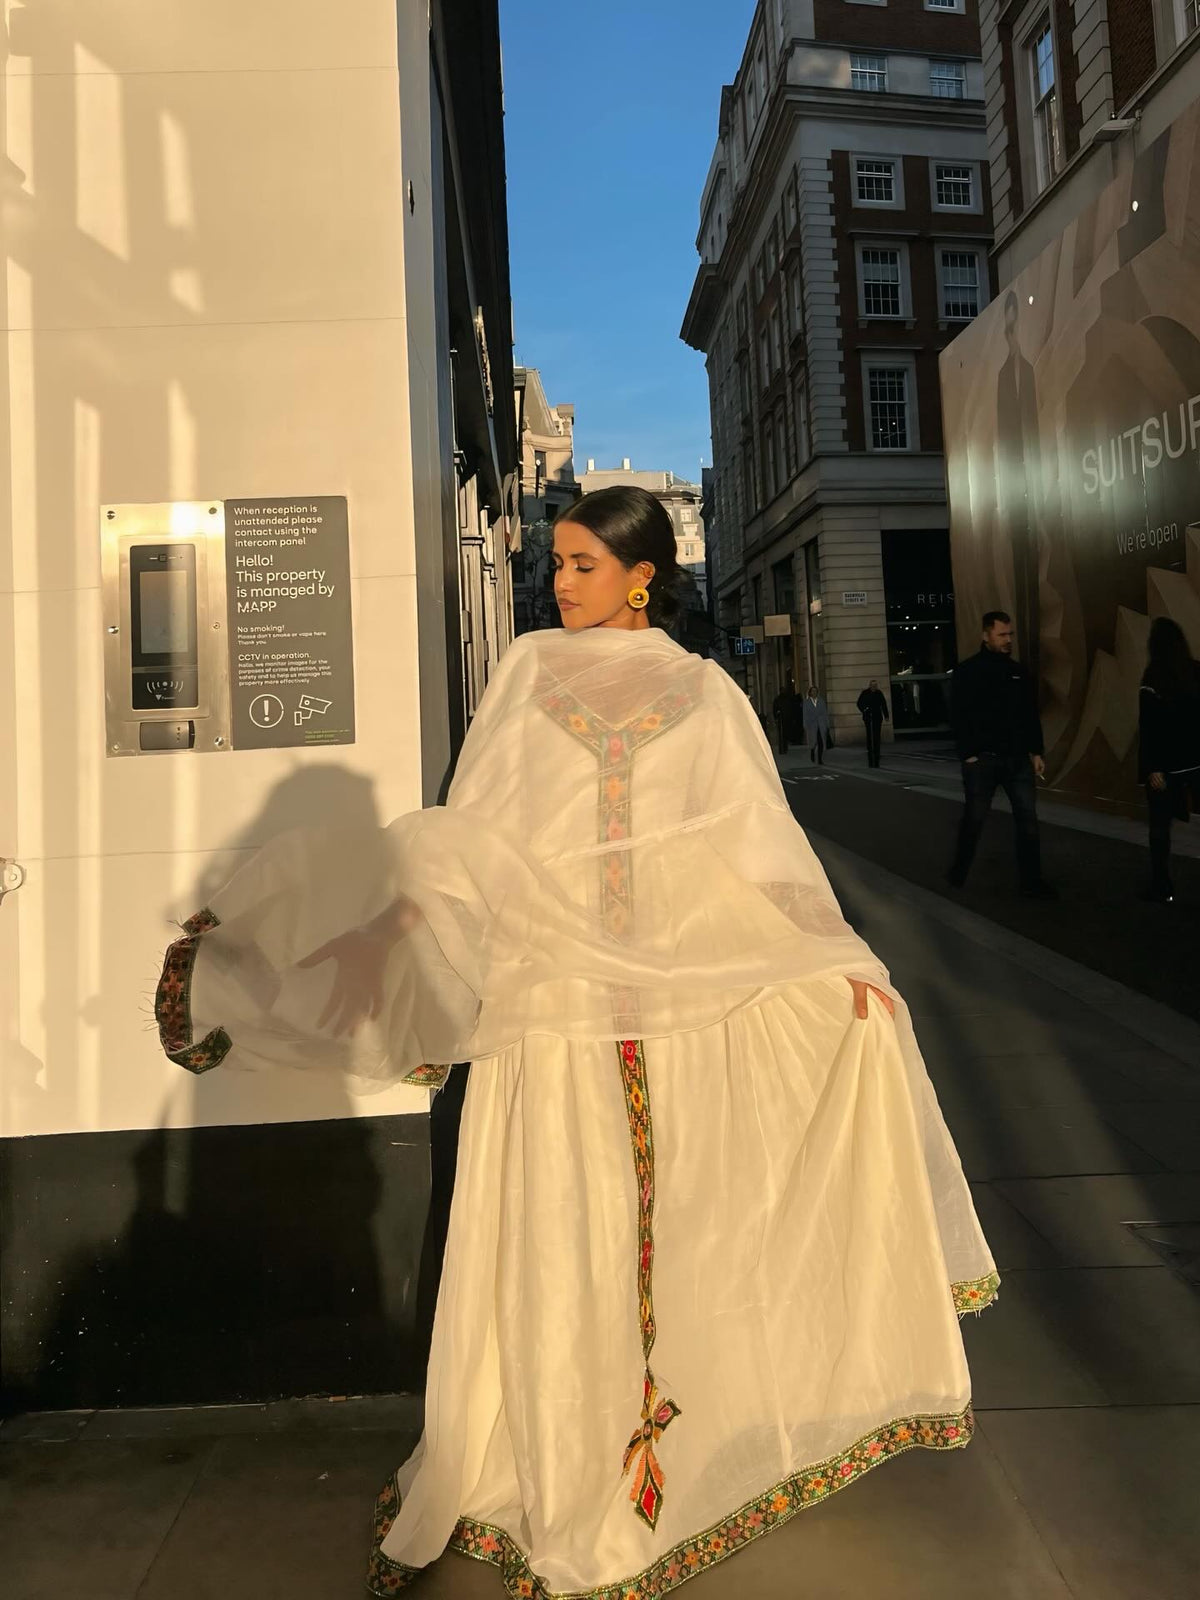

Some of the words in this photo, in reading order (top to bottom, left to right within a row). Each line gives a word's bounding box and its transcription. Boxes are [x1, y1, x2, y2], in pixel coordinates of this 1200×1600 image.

[234, 507, 260, 515] When
[262, 505, 307, 515] reception
[310, 505, 318, 513] is
[234, 517, 289, 526] unattended
[291, 515, 322, 525] please
[235, 528, 272, 537] contact
[274, 527, 299, 536] using
[302, 526, 317, 534] the
[235, 539, 277, 547] intercom
[280, 537, 306, 547] panel
[1116, 529, 1146, 556] We're
[1148, 522, 1178, 550] open
[236, 554, 273, 567] Hello!
[236, 570, 263, 582] This
[267, 568, 325, 584] property
[236, 586, 247, 598] is
[251, 583, 315, 599] managed
[319, 583, 335, 597] by
[237, 601, 277, 613] MAPP
[250, 625, 285, 633] smoking!
